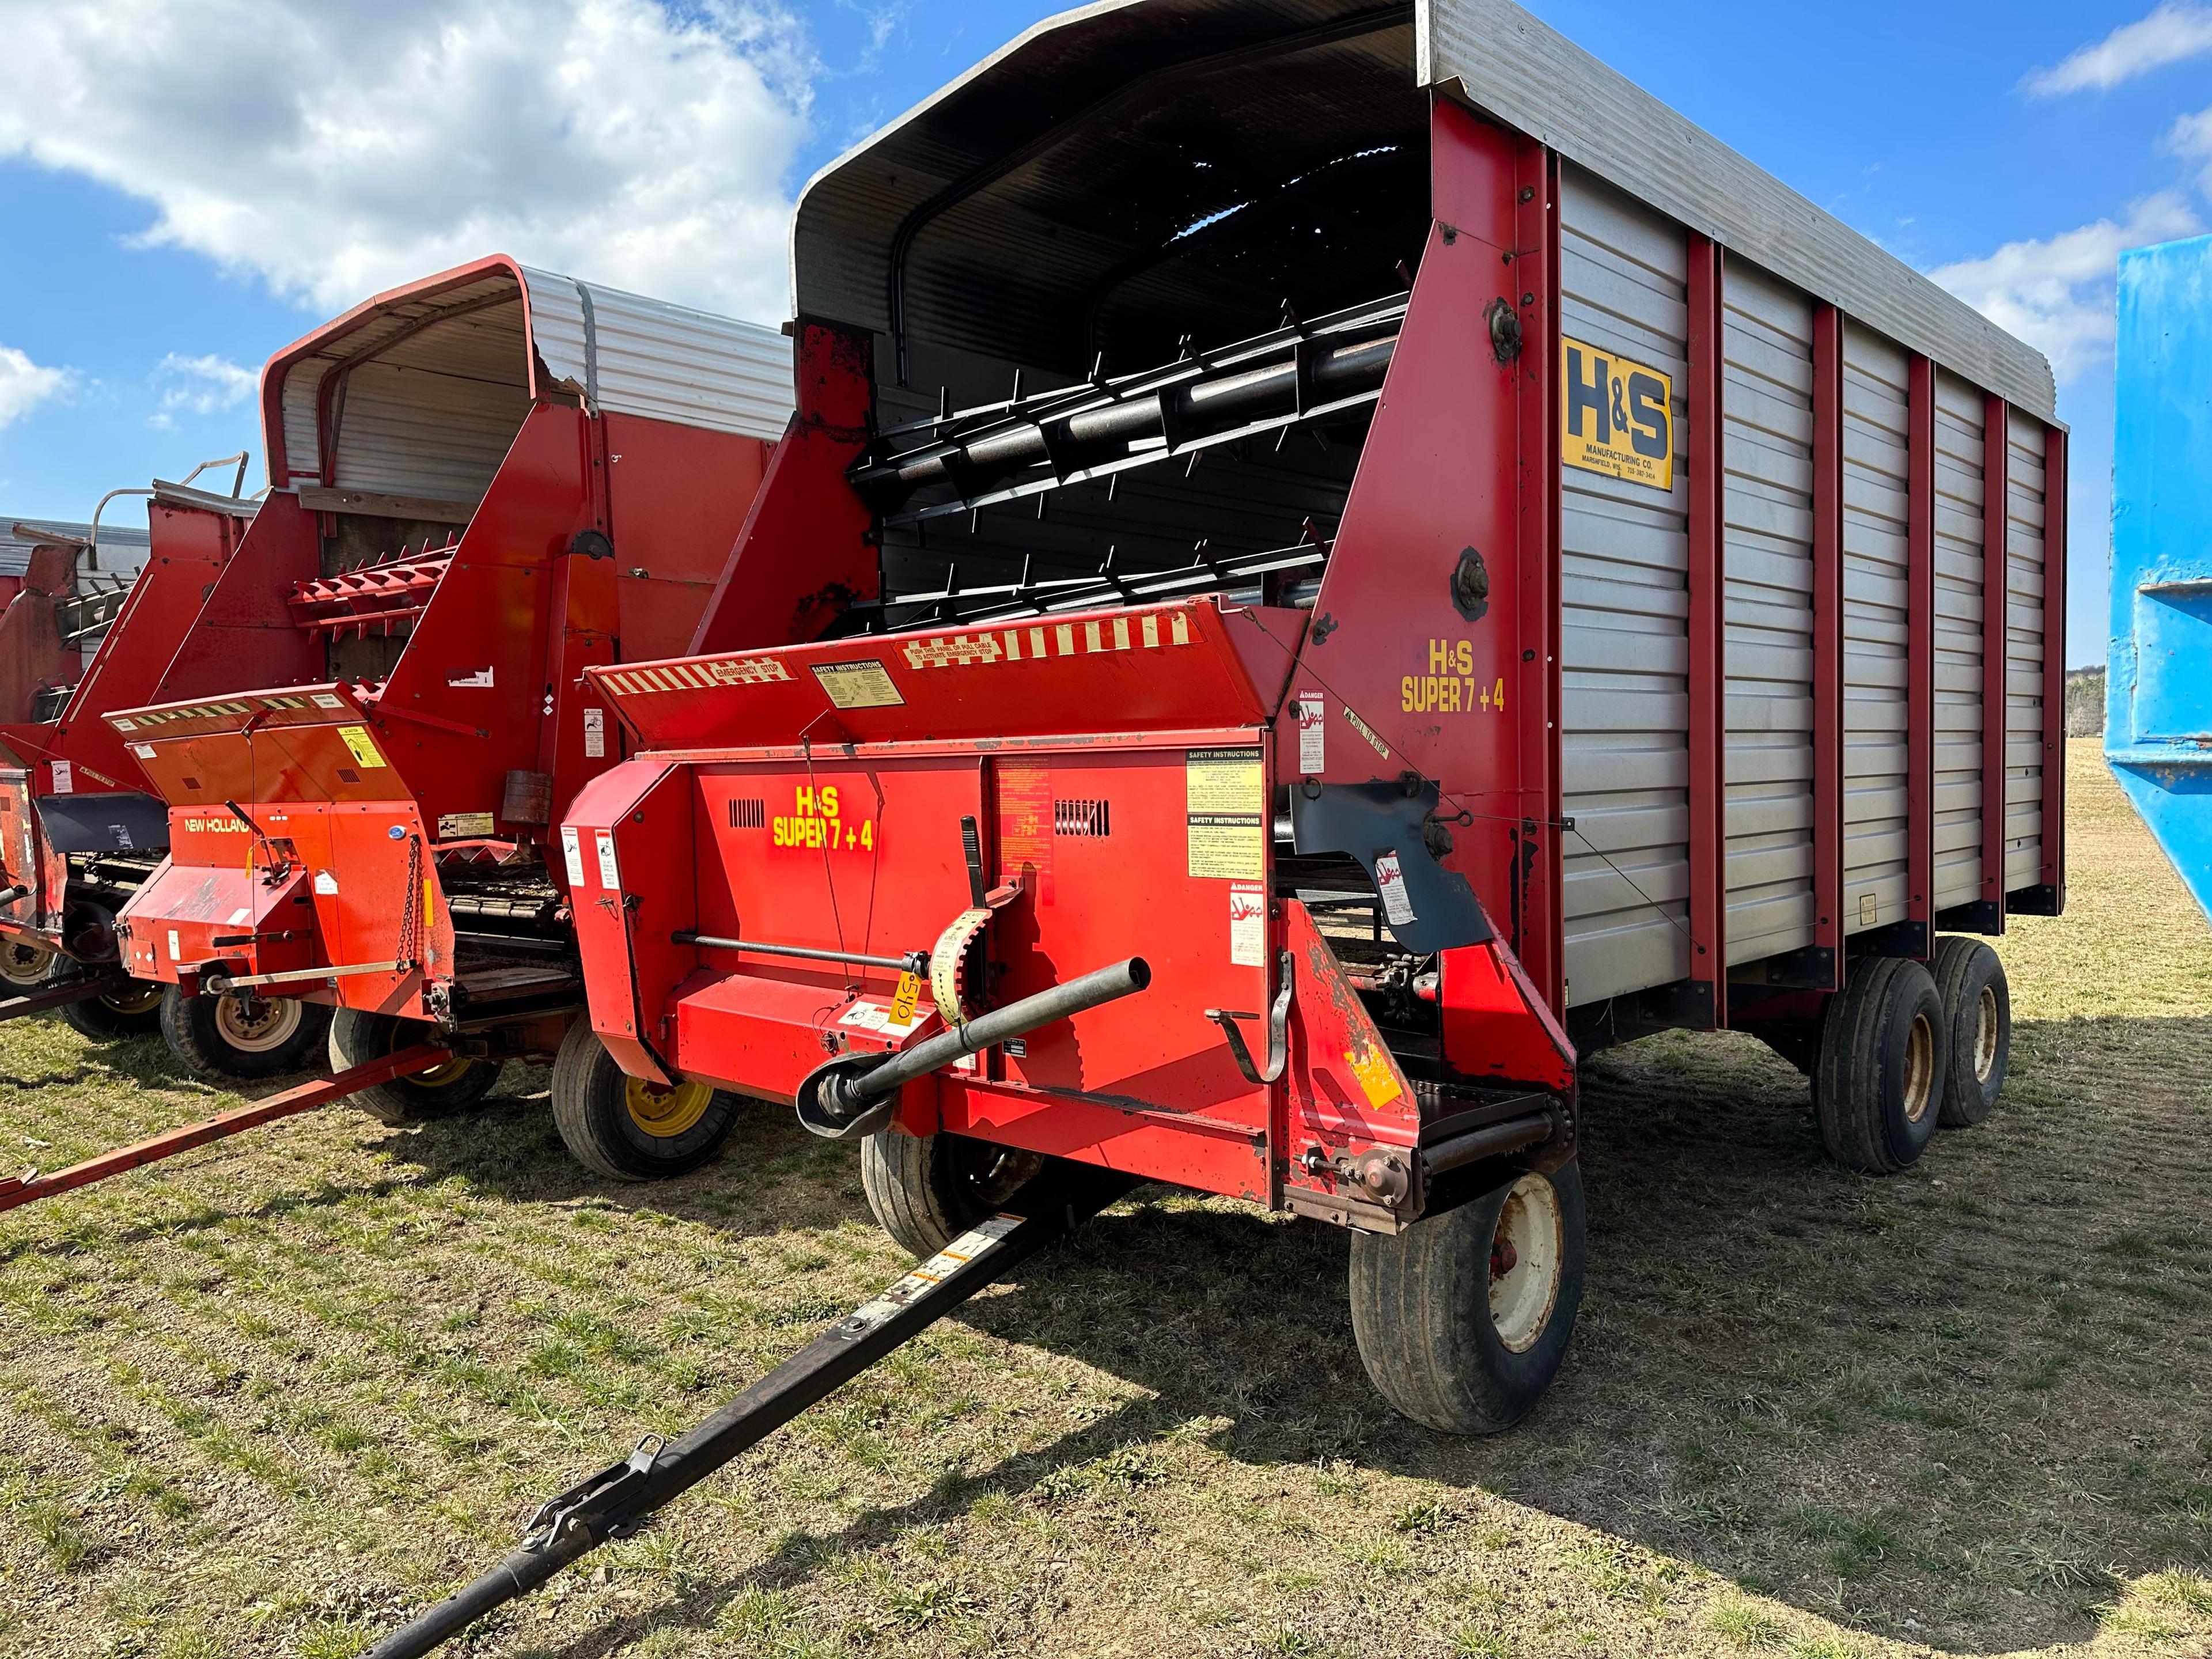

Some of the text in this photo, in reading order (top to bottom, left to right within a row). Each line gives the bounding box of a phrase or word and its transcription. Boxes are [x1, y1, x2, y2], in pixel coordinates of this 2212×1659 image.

[1567, 346, 1668, 460] H&S
[1582, 455, 1611, 469] MARSHFIELD,
[1586, 444, 1653, 469] MANUFACTURING CO.
[715, 664, 778, 677] EMERGENCY STOP
[811, 661, 882, 673] SAFETY INSTRUCTIONS
[1429, 639, 1473, 675] H&S
[1402, 676, 1461, 712] SUPER
[1465, 677, 1475, 712] 7
[1494, 678, 1505, 712] 4
[1351, 715, 1386, 755] PULL TO STOP
[796, 786, 839, 817] H&S
[184, 818, 249, 832] NEW HOLLAND
[773, 816, 827, 849] SUPER
[830, 819, 840, 850] 7
[861, 820, 873, 851] 4
[897, 980, 918, 1018] 540
